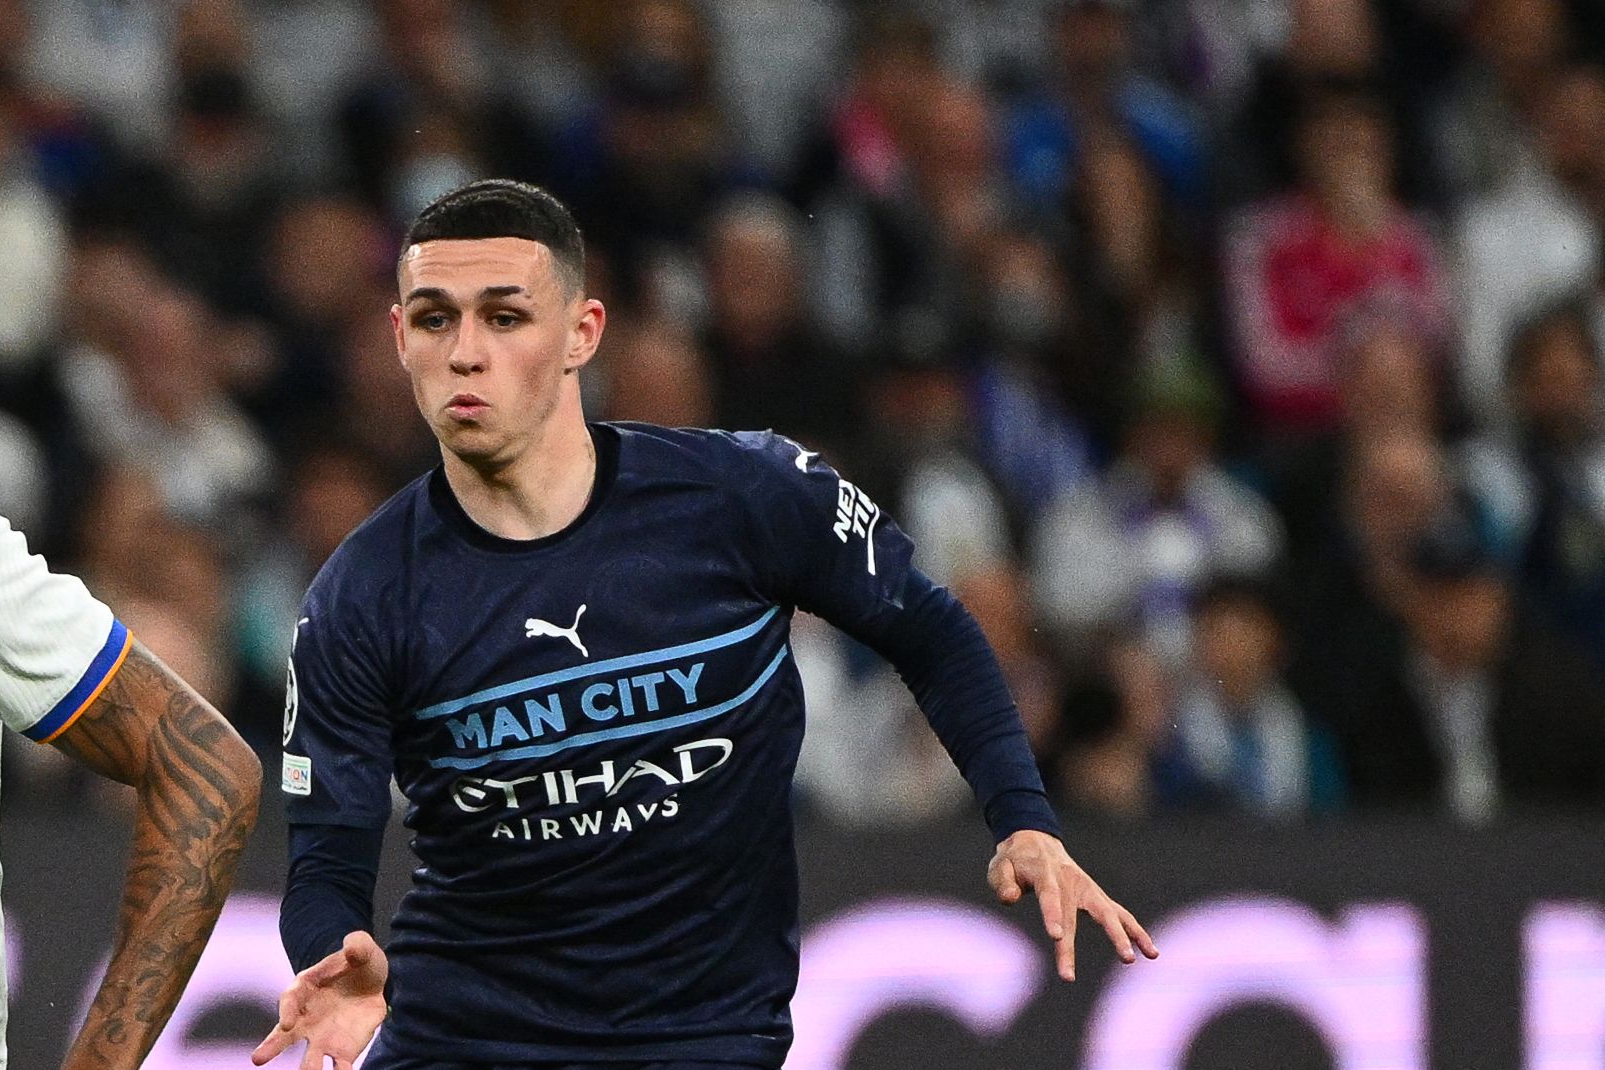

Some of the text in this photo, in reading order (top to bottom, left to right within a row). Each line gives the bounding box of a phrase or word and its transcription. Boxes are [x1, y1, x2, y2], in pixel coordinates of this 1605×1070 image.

[446, 662, 705, 749] MAN CITY
[451, 738, 734, 813] ETIHAD
[492, 793, 680, 840] AIRWAYS
